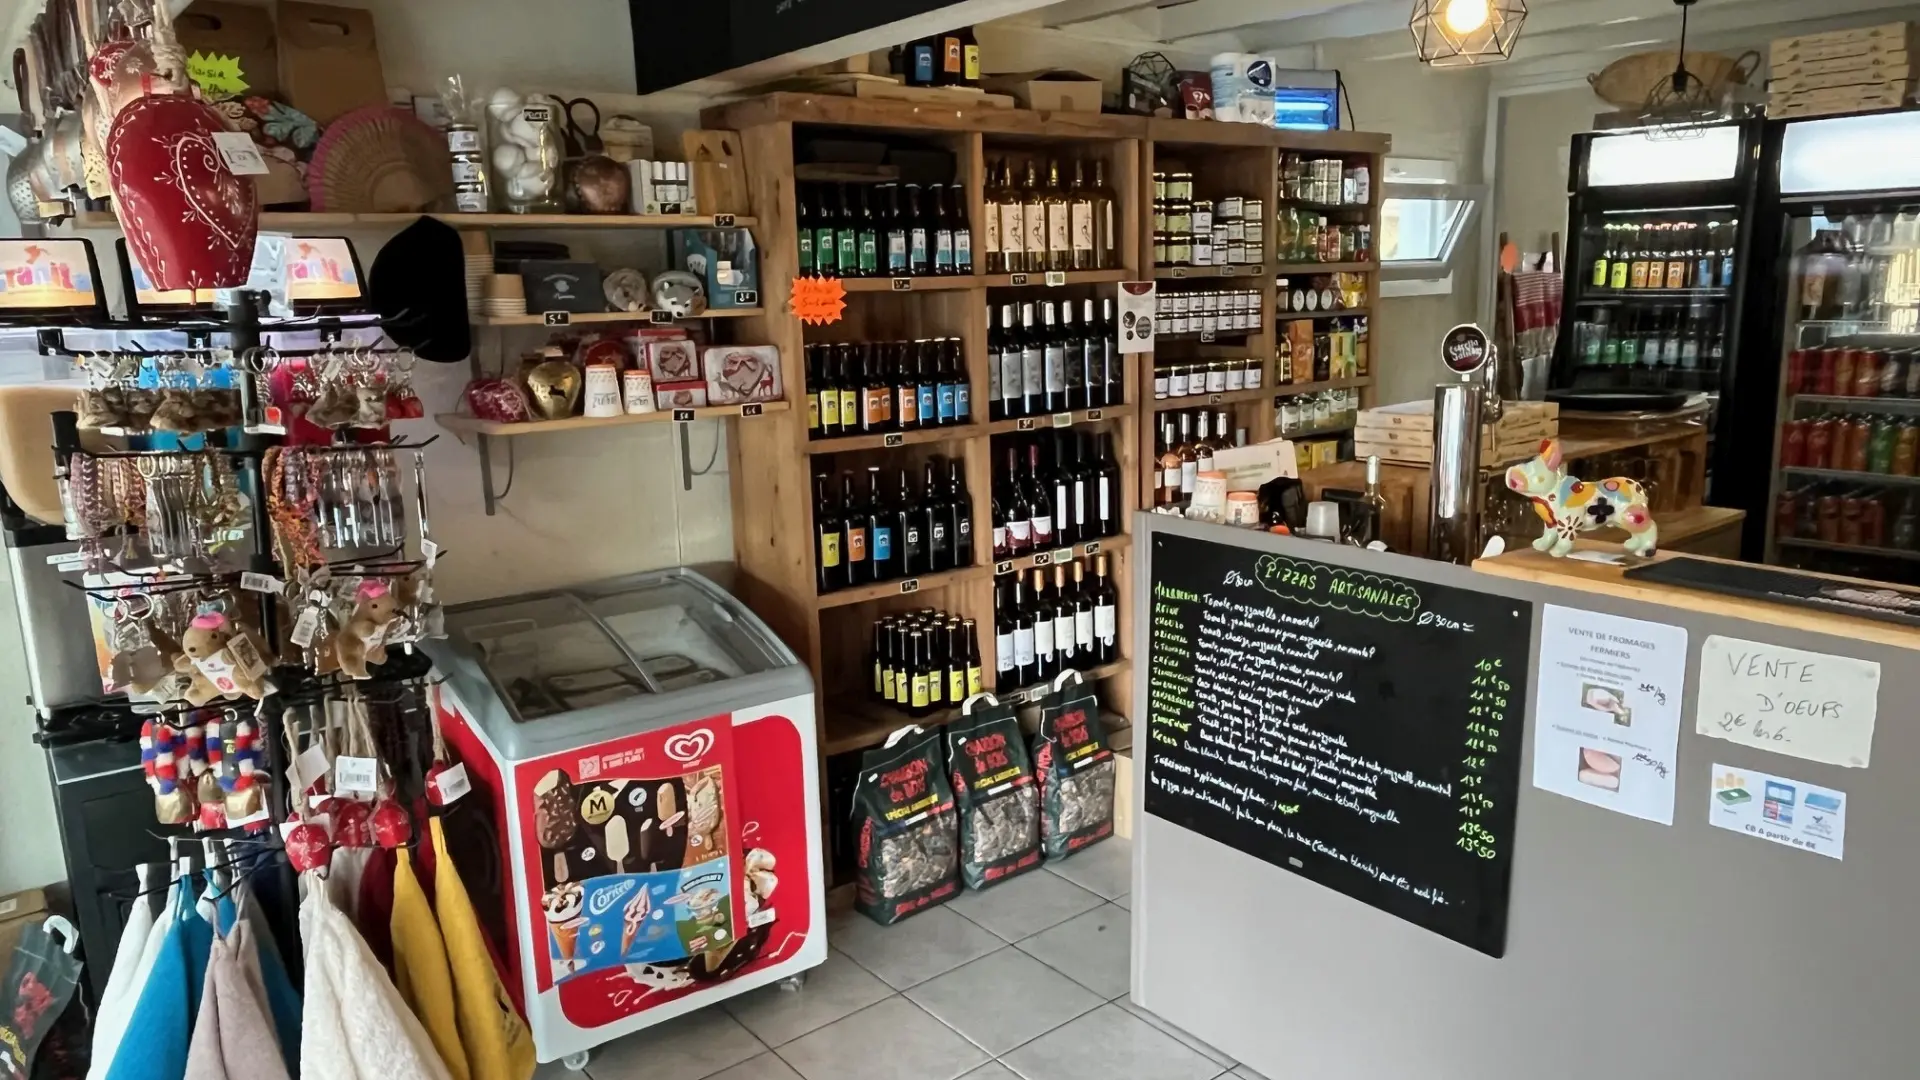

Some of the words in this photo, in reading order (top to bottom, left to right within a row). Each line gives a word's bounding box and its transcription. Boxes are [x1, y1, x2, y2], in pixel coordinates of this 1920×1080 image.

[1265, 562, 1317, 591] PIZZAS
[1329, 578, 1413, 609] ARTISANALES
[1568, 626, 1594, 639] VENTE
[1595, 632, 1606, 641] DE
[1608, 635, 1656, 651] FROMAGES
[1590, 645, 1631, 660] FERMIERS
[1727, 652, 1816, 683] VENTE
[1756, 692, 1843, 719] D'OEUFS
[1717, 711, 1747, 733] 2€
[1766, 831, 1791, 843] partir
[1792, 836, 1804, 847] de
